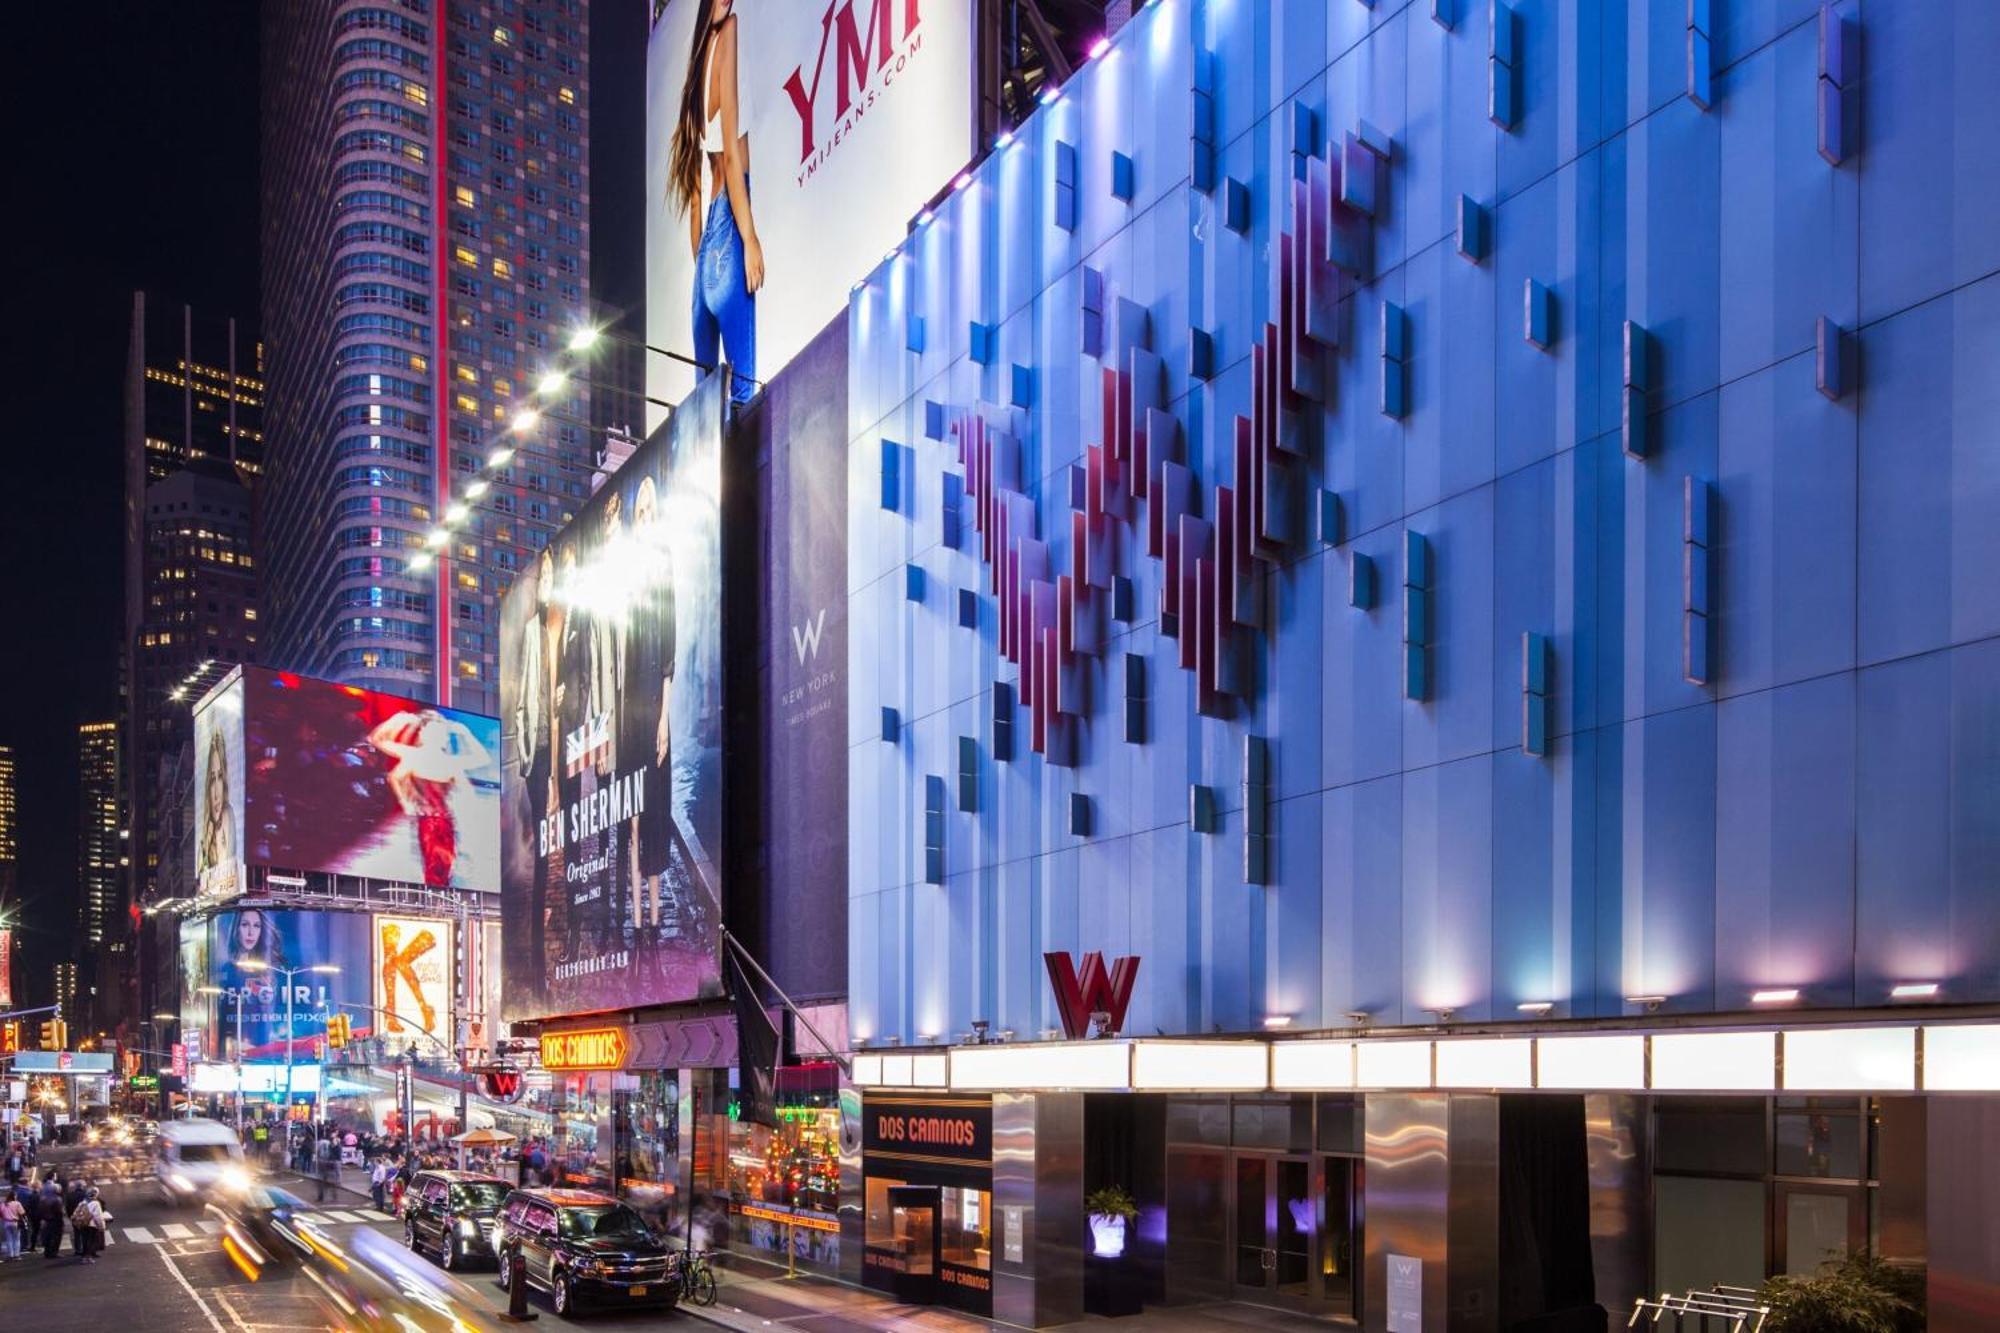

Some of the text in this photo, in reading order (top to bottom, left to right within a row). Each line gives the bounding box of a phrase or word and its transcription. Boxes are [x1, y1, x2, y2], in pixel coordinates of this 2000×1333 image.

[797, 34, 922, 188] YMIJEANS.COM
[792, 607, 826, 667] W
[782, 671, 836, 706] NEW YORK
[540, 767, 645, 858] BEN SHERMAN
[567, 848, 609, 883] Original
[1043, 949, 1142, 1040] W
[544, 1031, 617, 1067] DOS CAMINOS
[488, 1071, 521, 1096] W
[878, 1115, 975, 1147] DOS CAMINOS
[941, 1267, 990, 1291] DOS CAMINOS
